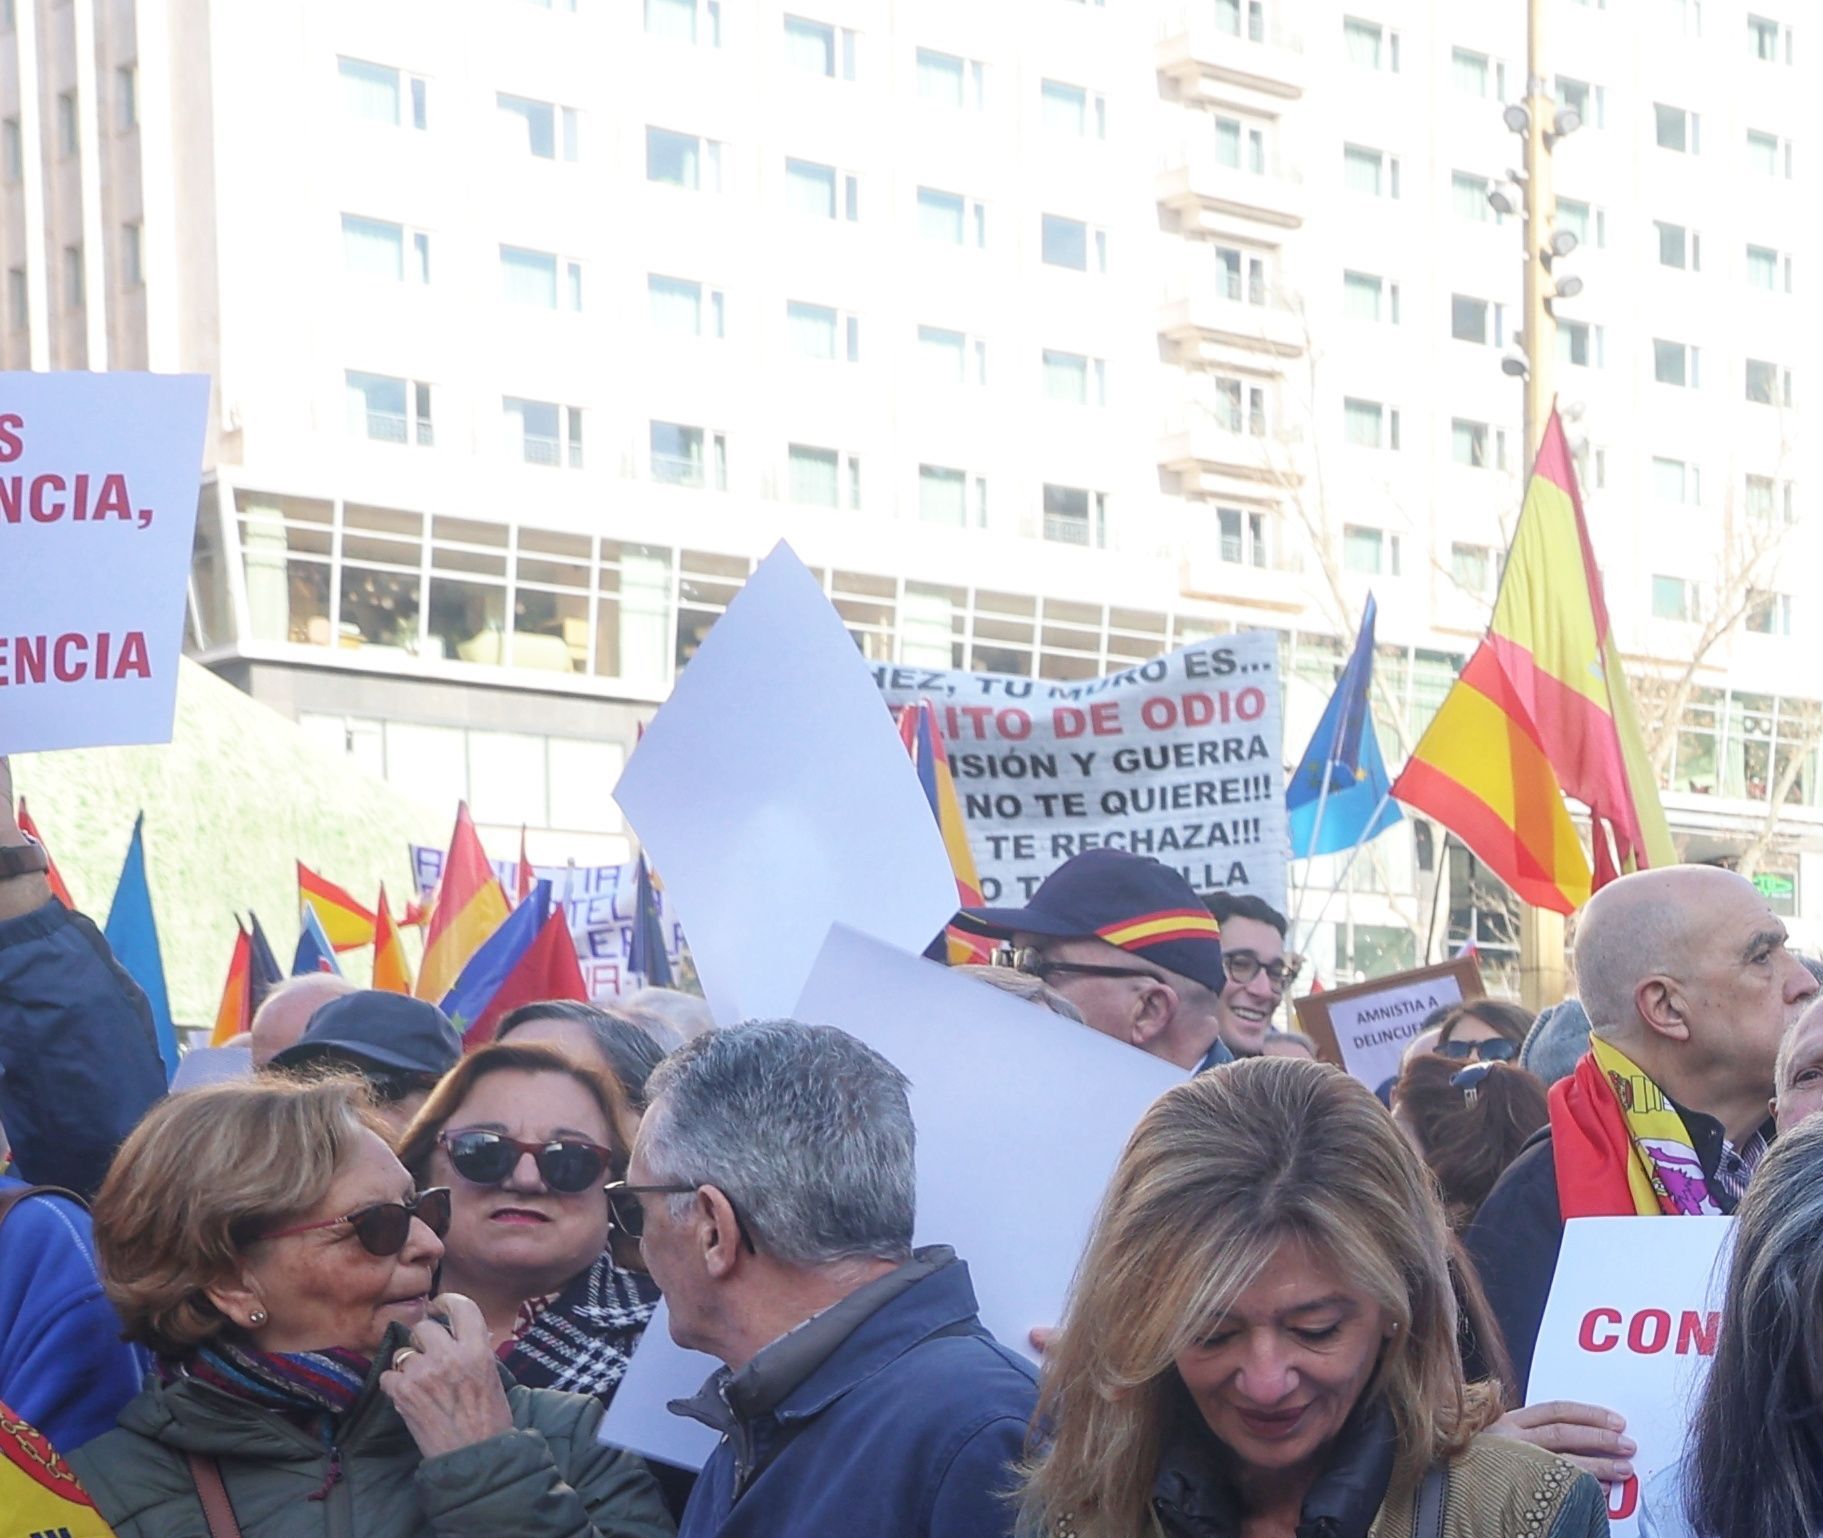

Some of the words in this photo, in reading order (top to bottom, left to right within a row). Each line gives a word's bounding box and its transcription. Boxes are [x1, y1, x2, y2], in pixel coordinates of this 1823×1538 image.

[0, 632, 151, 686] NCIA
[975, 677, 1032, 698] TU
[1052, 702, 1123, 739] DE
[1141, 687, 1266, 731] ODIO
[1072, 752, 1096, 777] Y
[1113, 733, 1269, 774] GUERRA
[967, 793, 1021, 819] NO
[1033, 793, 1087, 818] TE
[1100, 774, 1272, 816] QUIERE!!!
[986, 834, 1035, 860] TE
[1051, 818, 1260, 859] RECHAZA!!!
[1357, 999, 1425, 1024] AMNISTIA
[1428, 996, 1439, 1007] A
